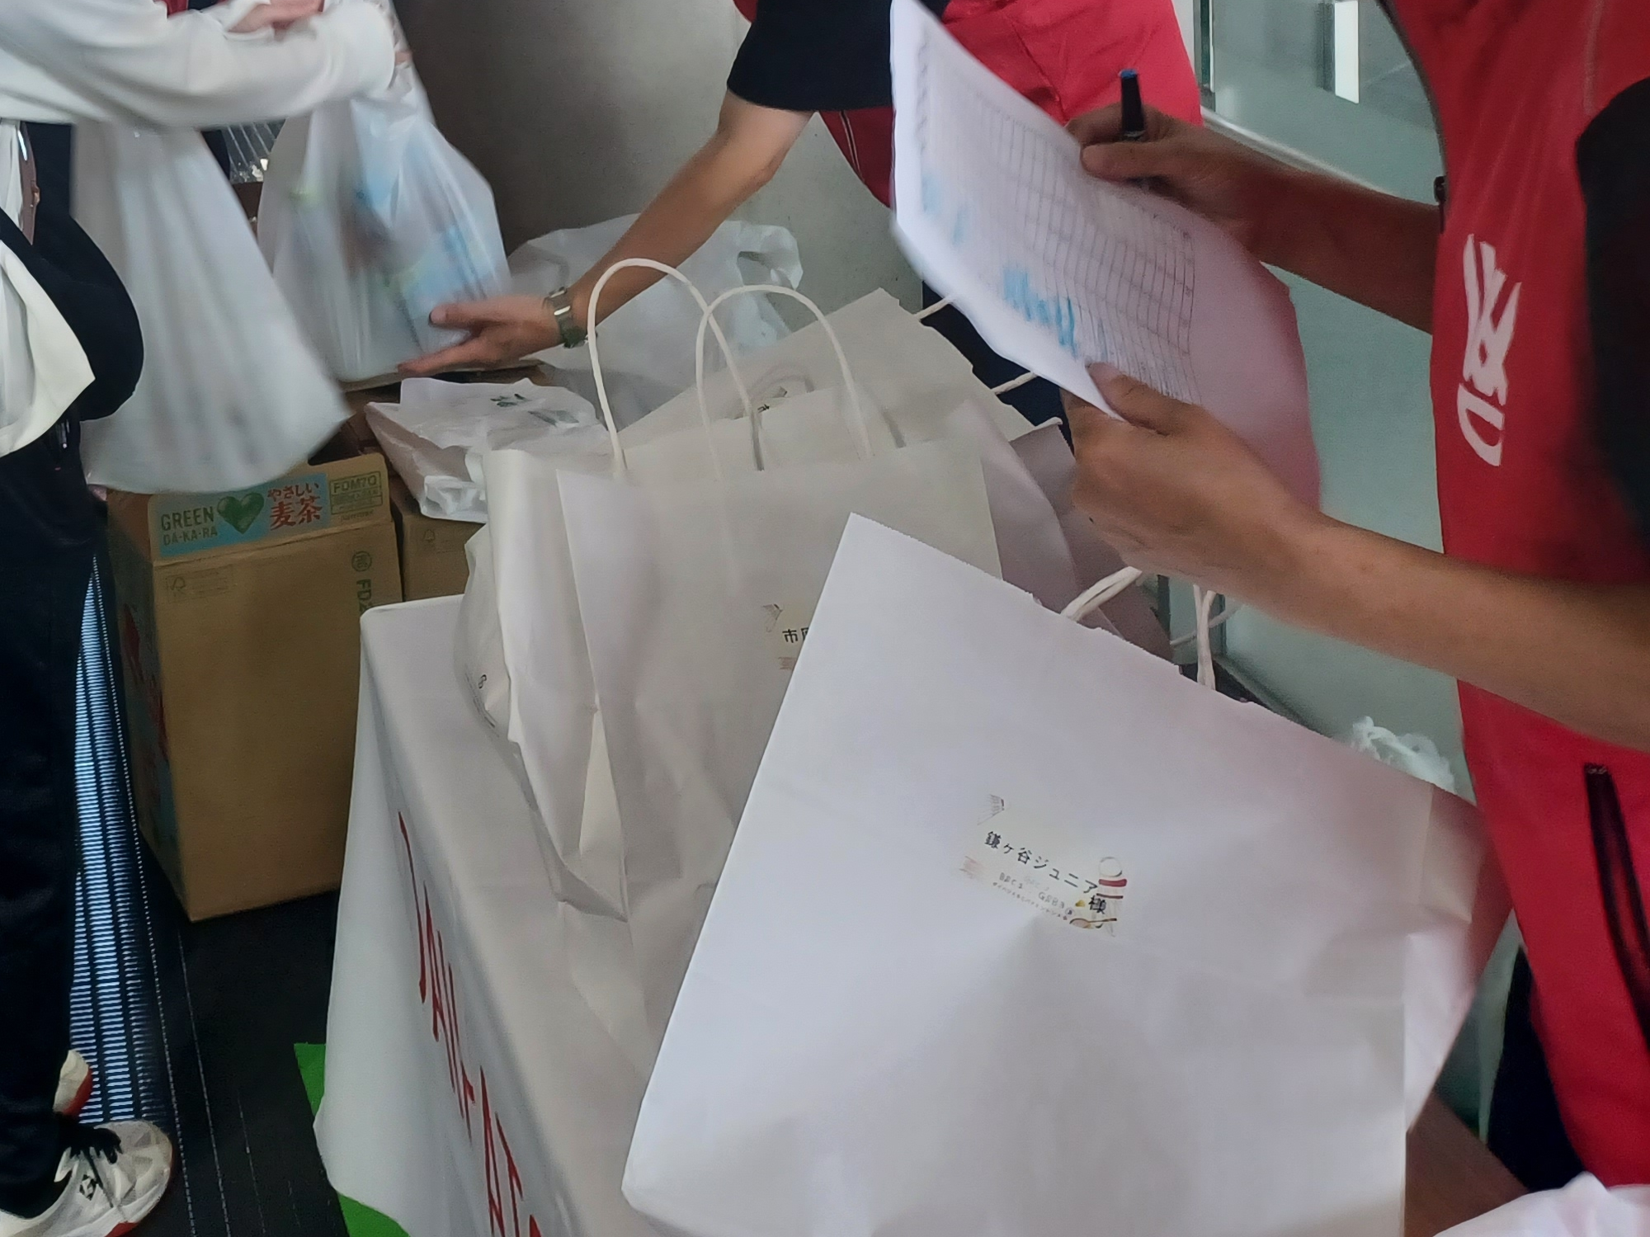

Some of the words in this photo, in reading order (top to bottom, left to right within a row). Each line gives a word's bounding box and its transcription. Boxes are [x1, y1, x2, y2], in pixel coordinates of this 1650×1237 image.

[267, 482, 319, 503] やさしい
[160, 506, 215, 532] GREEN
[269, 495, 323, 531] 麦茶
